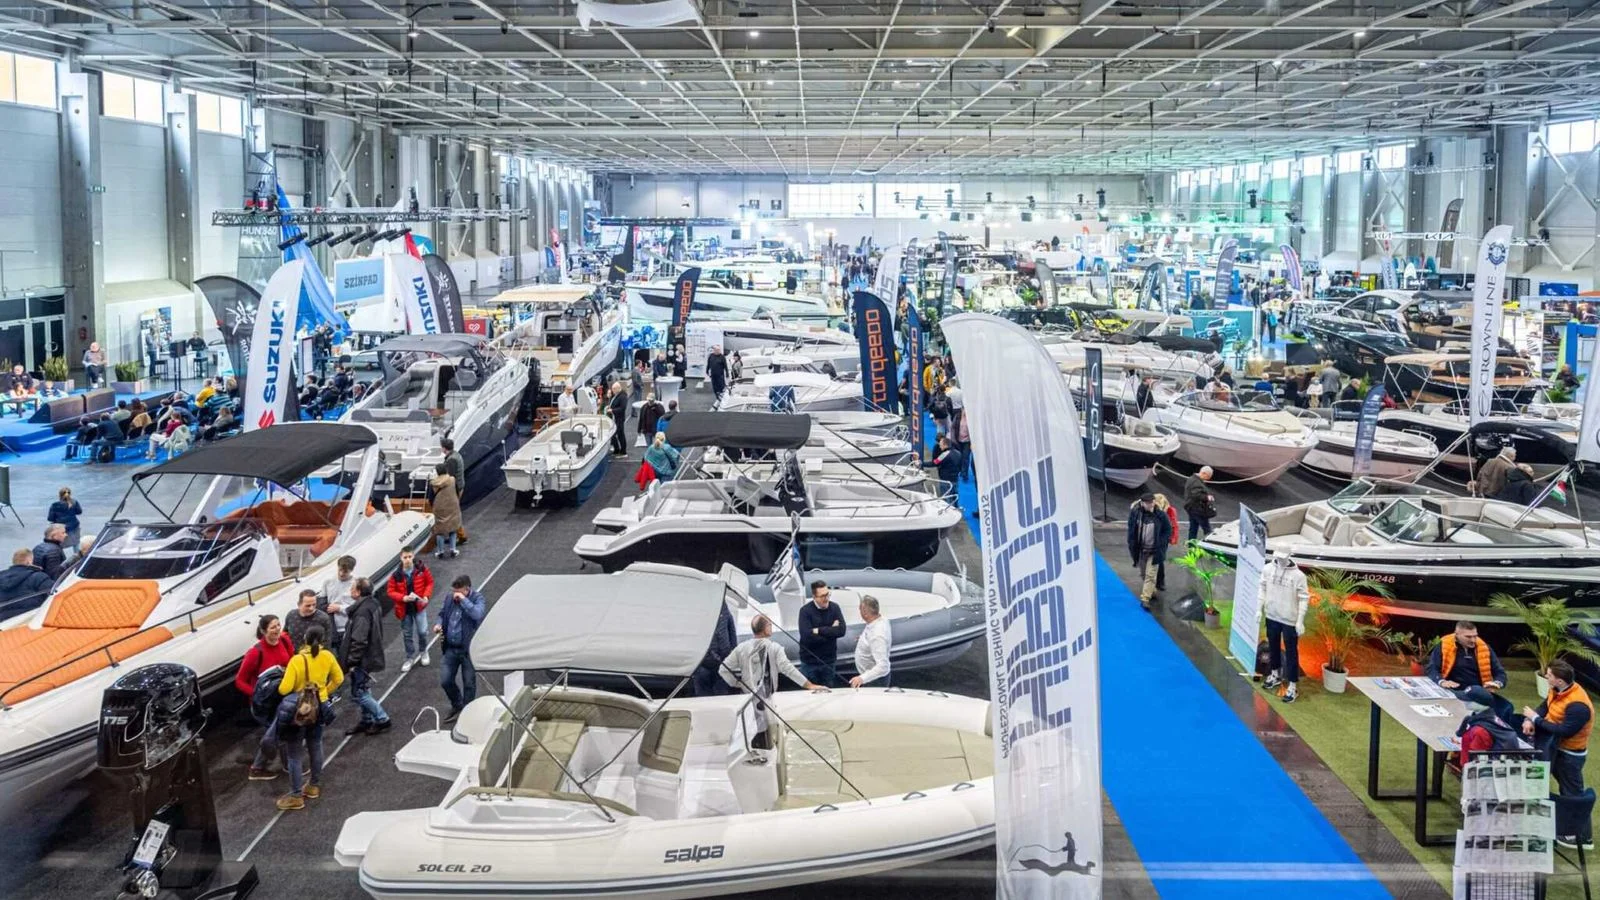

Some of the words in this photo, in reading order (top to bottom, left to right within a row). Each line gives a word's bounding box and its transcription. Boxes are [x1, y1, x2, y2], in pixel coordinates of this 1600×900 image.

[1481, 275, 1497, 387] CROWNLINE
[263, 300, 286, 403] SUZUKI
[103, 716, 129, 725] 175
[664, 844, 725, 864] salpa
[417, 863, 467, 874] SOLEIL
[470, 863, 492, 873] 20
